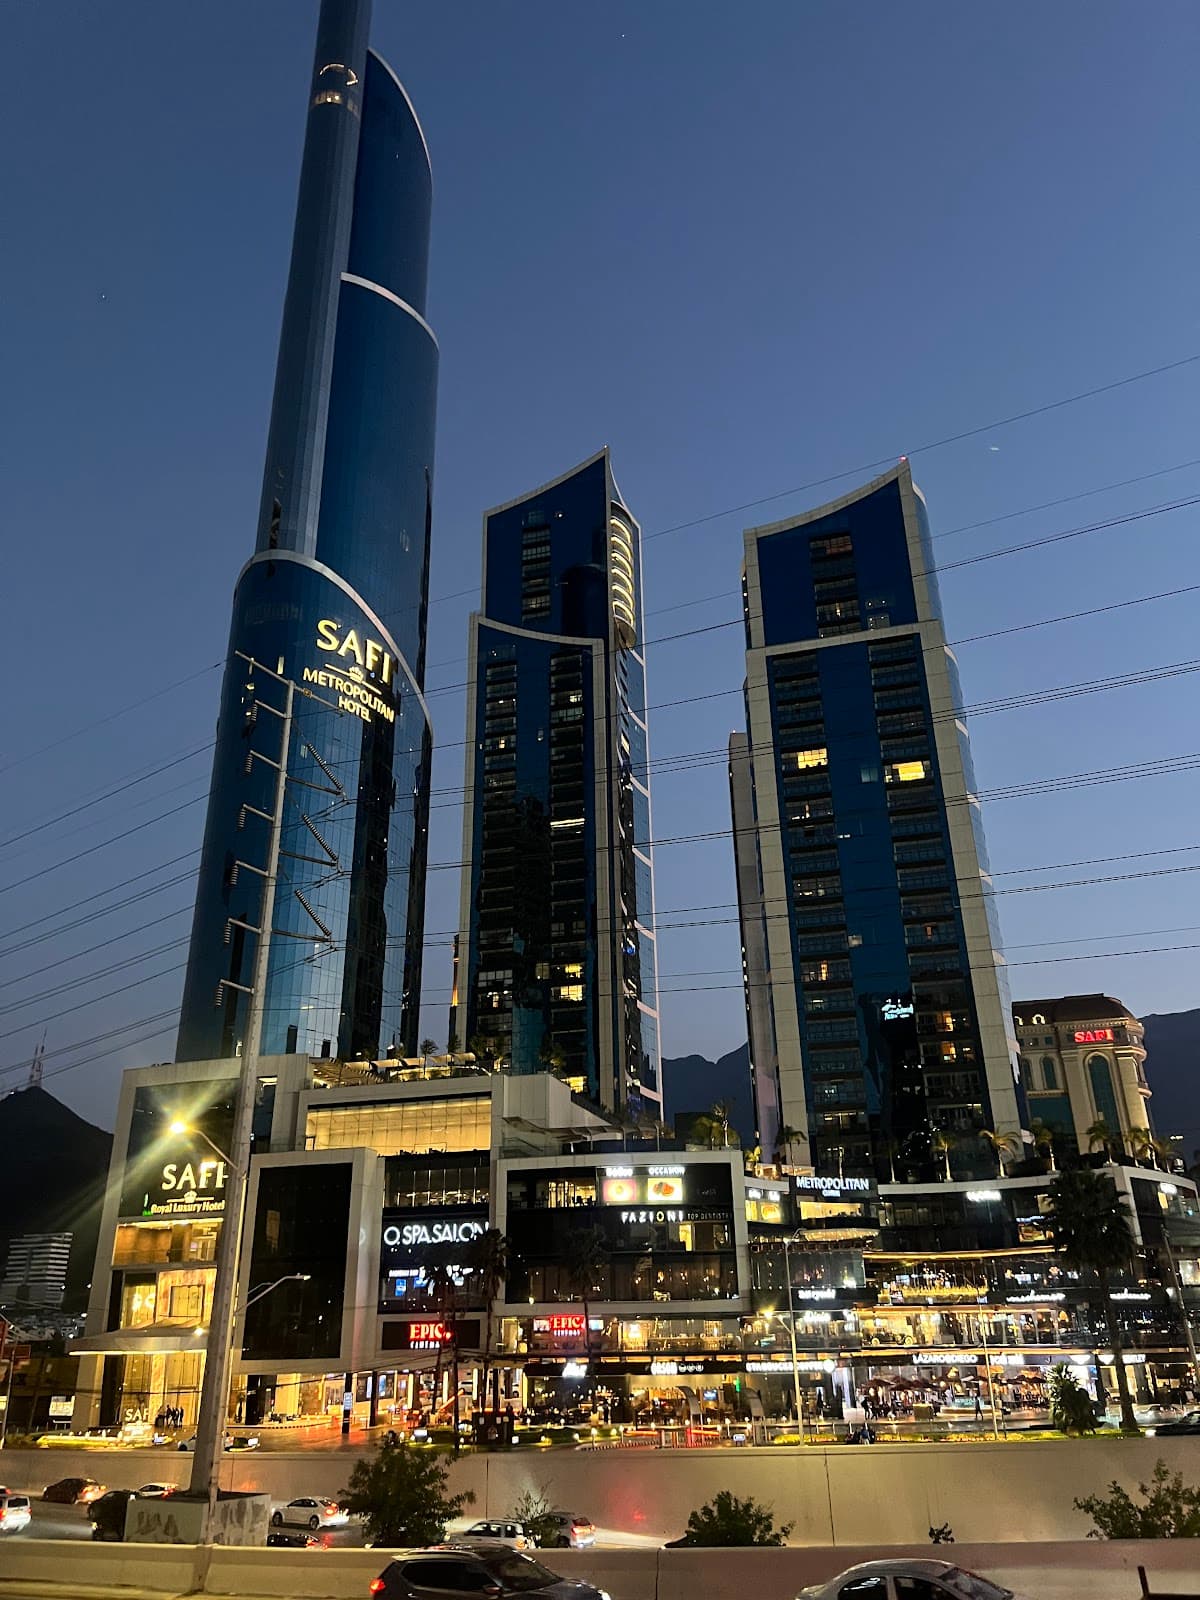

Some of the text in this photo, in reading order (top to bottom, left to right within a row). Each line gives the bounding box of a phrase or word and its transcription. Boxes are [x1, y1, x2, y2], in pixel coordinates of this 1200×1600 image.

[316, 619, 392, 684] SAFI
[303, 667, 395, 723] METROPOLITAN
[338, 696, 372, 723] HOTEL
[1074, 1029, 1114, 1043] SAFI
[161, 1161, 225, 1190] SAFI
[796, 1176, 869, 1190] METROPOLITAN
[151, 1199, 226, 1214] Royal Luxury Hotel
[621, 1210, 684, 1223] FAZIONI
[553, 1316, 582, 1329] EPIC
[410, 1323, 444, 1339] EPIC
